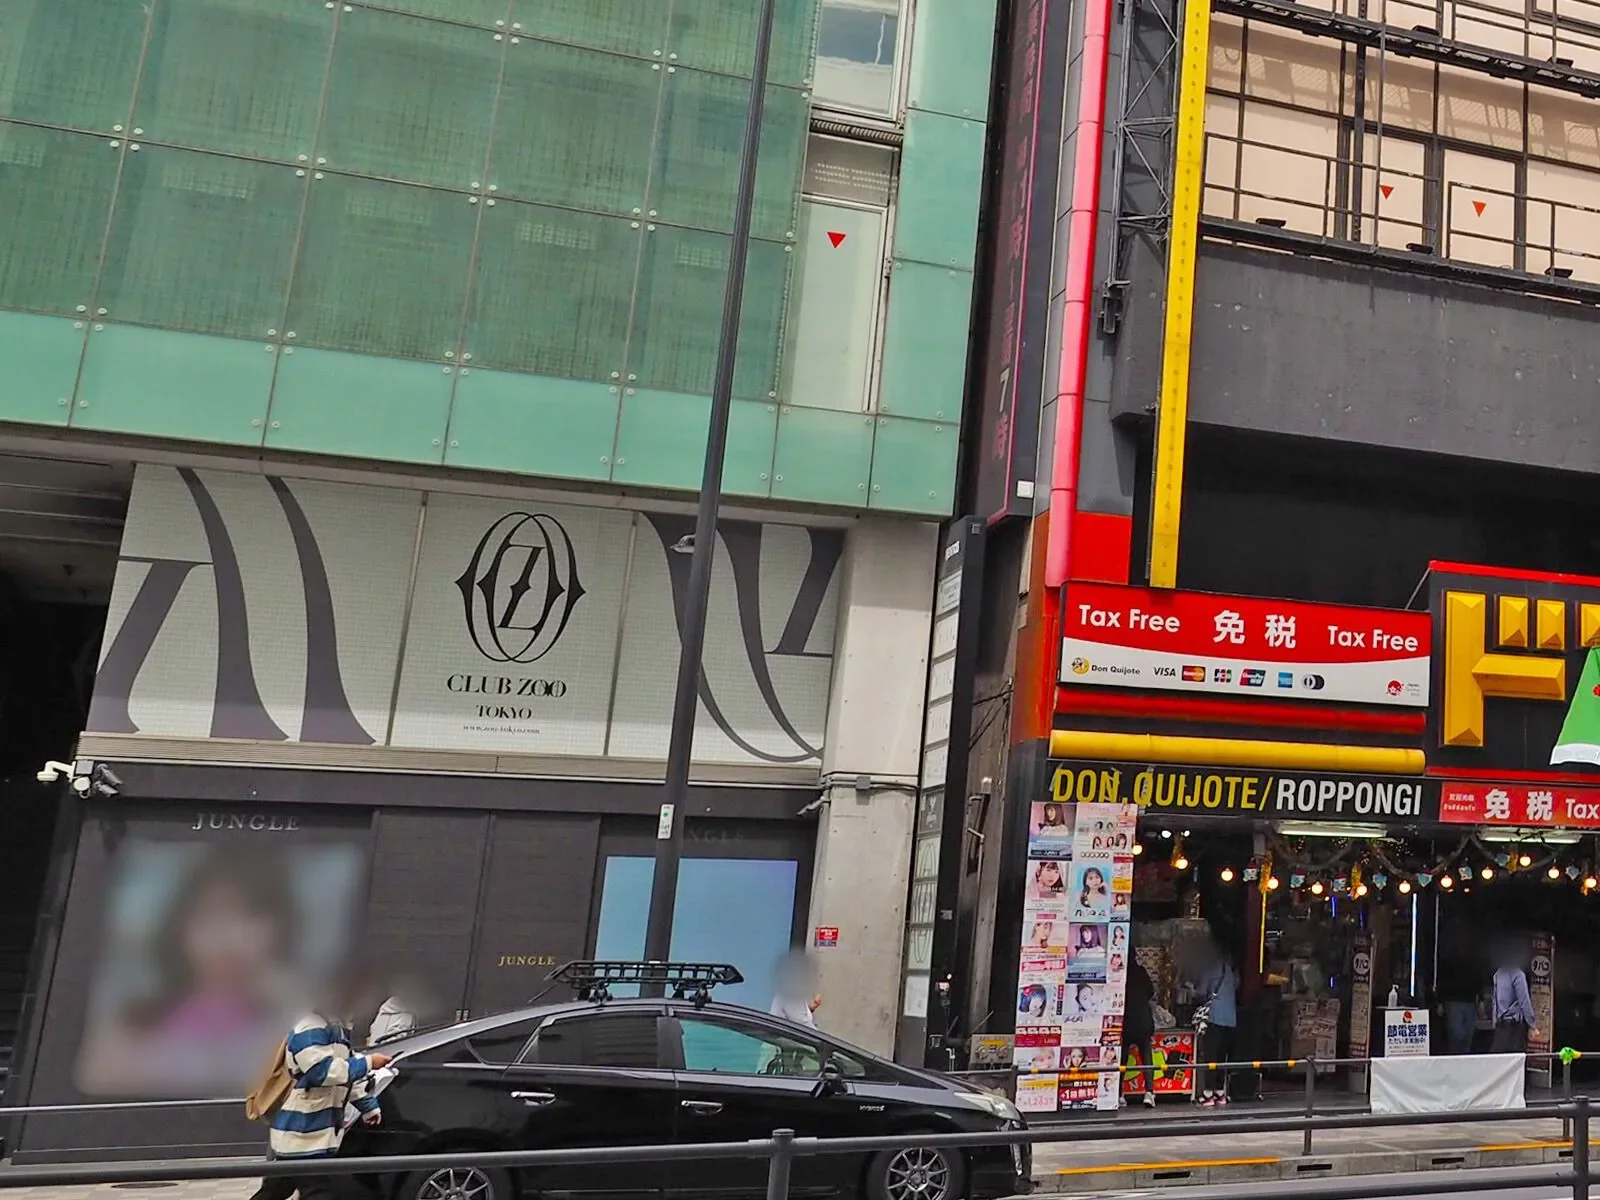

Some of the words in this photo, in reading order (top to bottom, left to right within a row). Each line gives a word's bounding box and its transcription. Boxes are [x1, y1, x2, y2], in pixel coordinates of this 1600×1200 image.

[1079, 604, 1121, 629] Tax
[1129, 608, 1180, 633] Free
[1212, 609, 1297, 649] 免税
[1328, 625, 1366, 648] Tax
[1372, 628, 1419, 652] Free
[1091, 664, 1108, 674] Don
[1110, 665, 1141, 676] Quijote
[1153, 666, 1176, 677] VISA
[447, 673, 511, 696] CLUB
[517, 678, 567, 698] ZOO
[476, 704, 532, 719] TOKYO
[1484, 789, 1553, 821] 免税
[1566, 799, 1600, 819] Tax
[192, 813, 300, 830] JUNGLE
[498, 956, 555, 966] JUNGLE
[1534, 960, 1550, 971] タバコ
